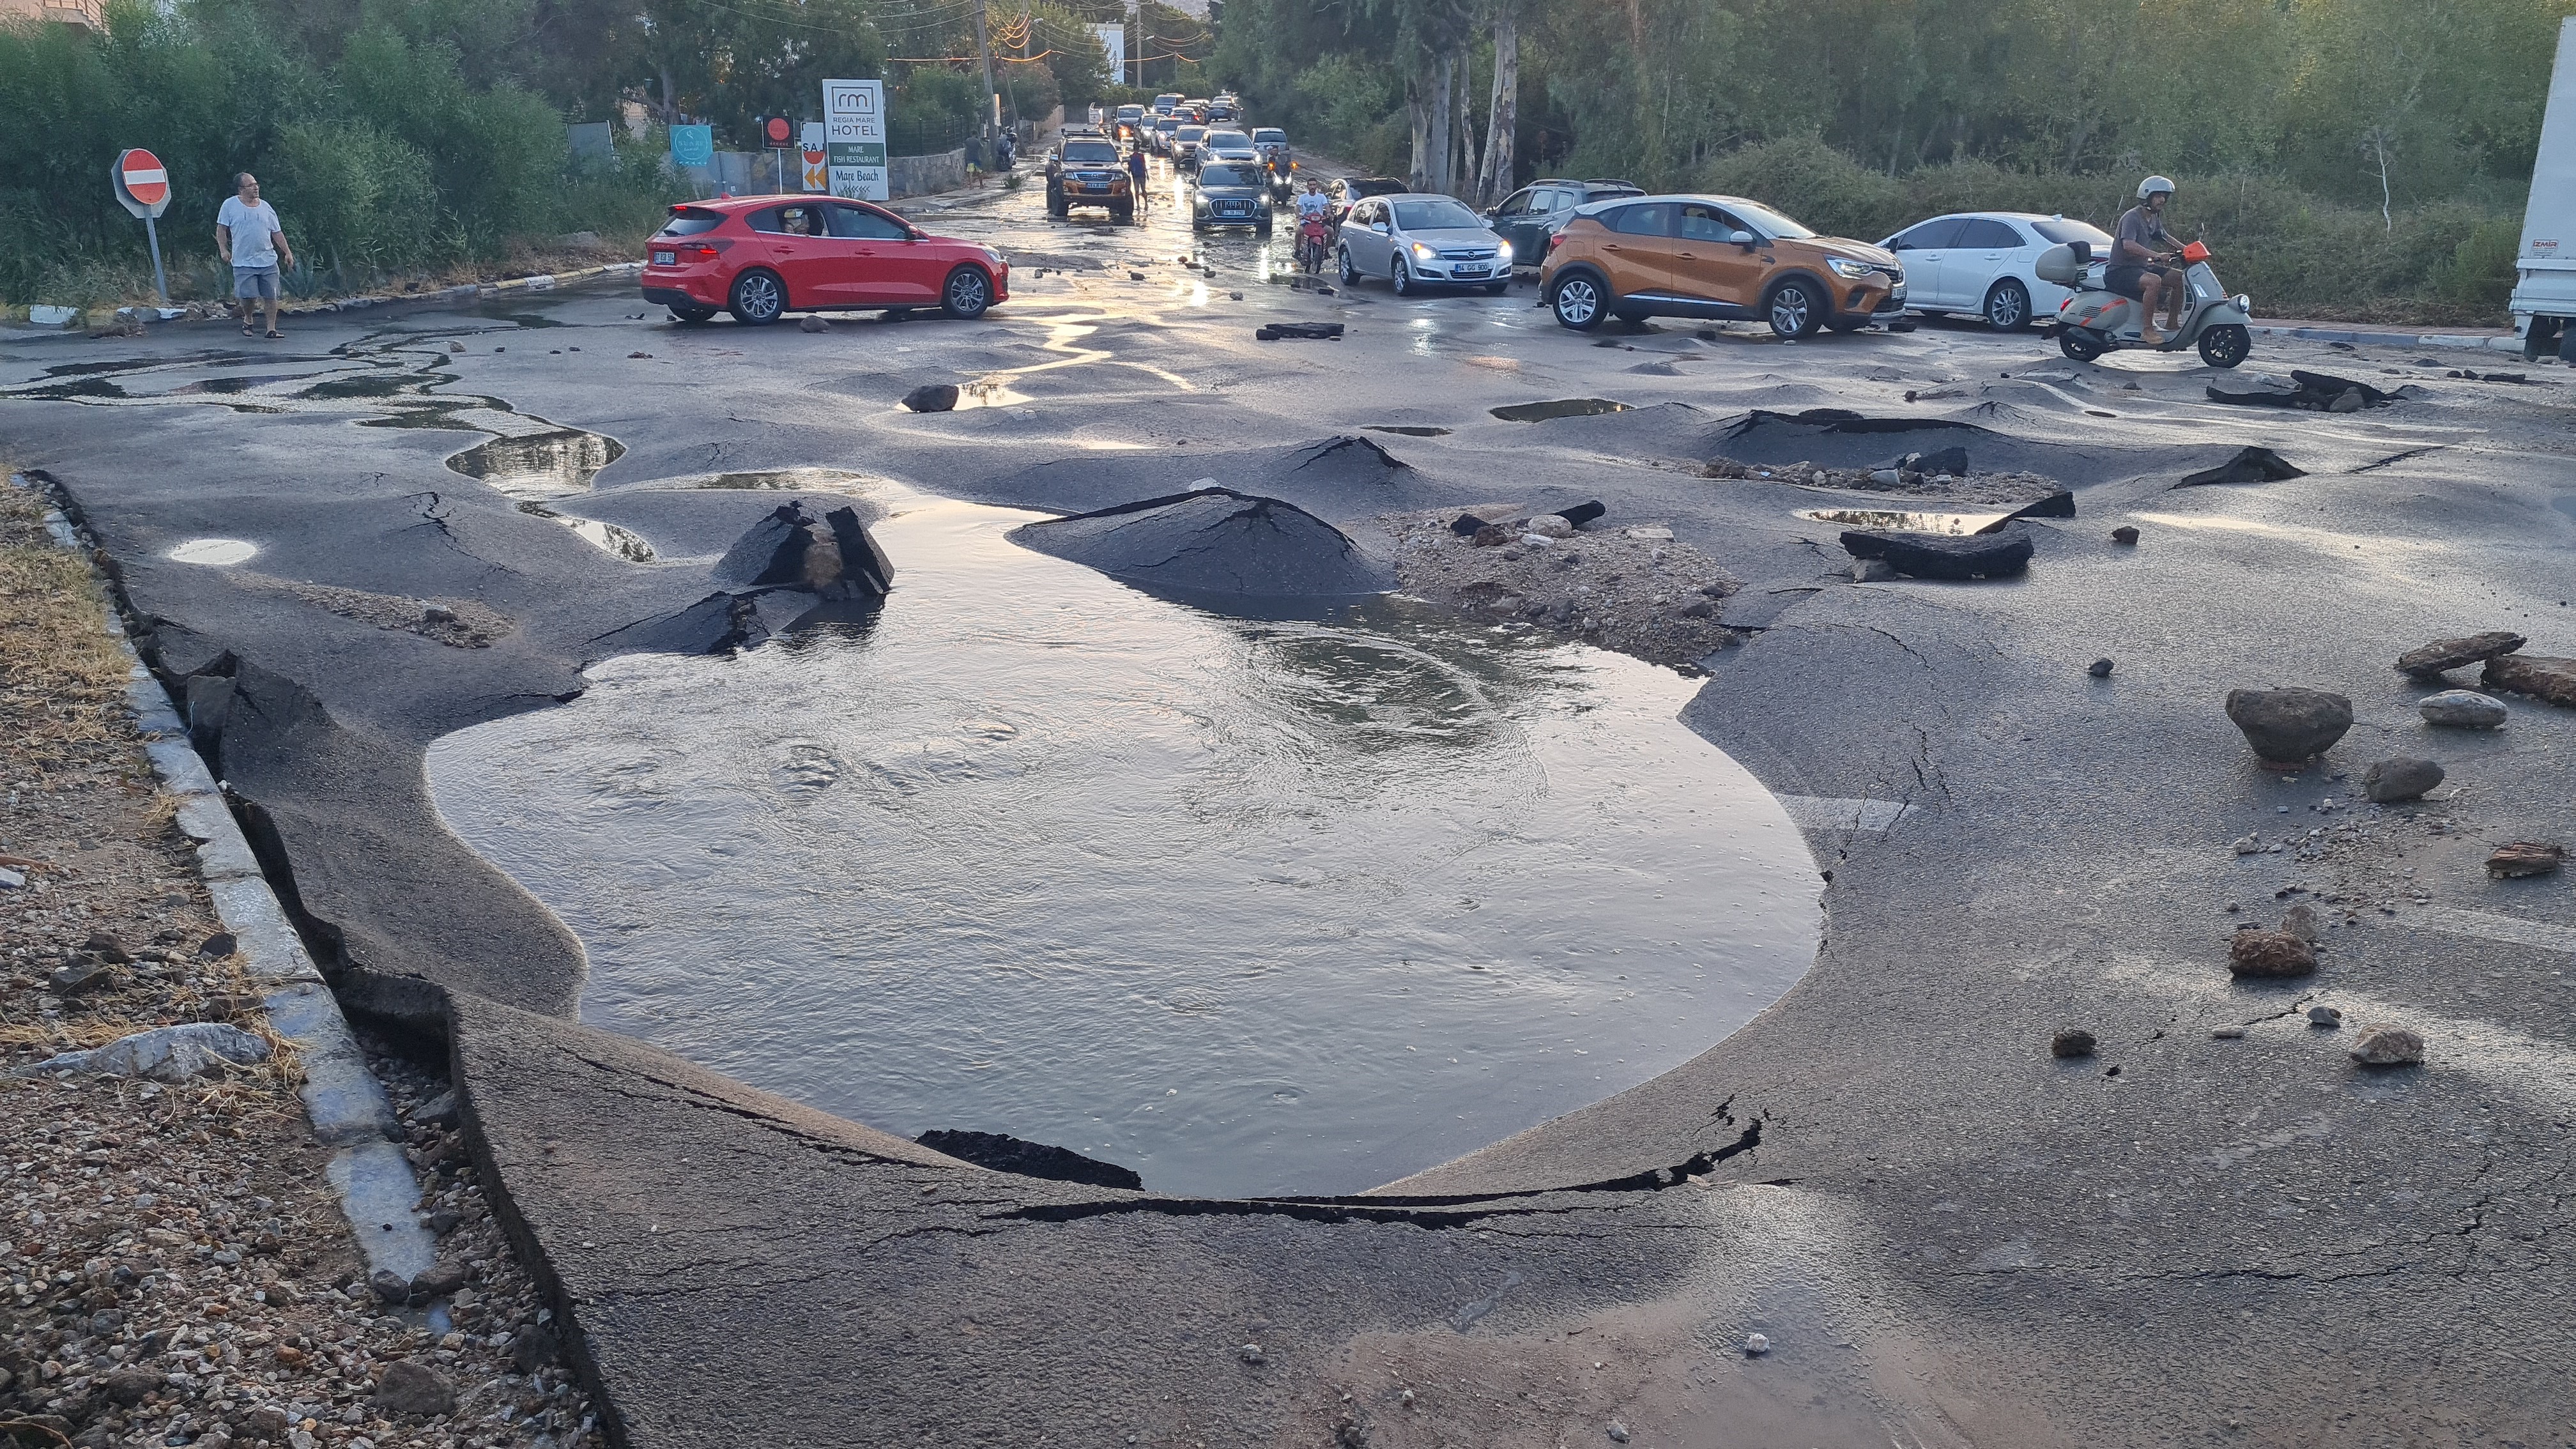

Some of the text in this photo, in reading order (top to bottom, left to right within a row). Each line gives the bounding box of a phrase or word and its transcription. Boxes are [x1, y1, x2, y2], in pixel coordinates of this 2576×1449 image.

[838, 93, 868, 107] rm
[831, 125, 878, 136] HOTEL
[846, 155, 880, 164] RESTAURANT
[836, 168, 879, 181] Mare Beach
